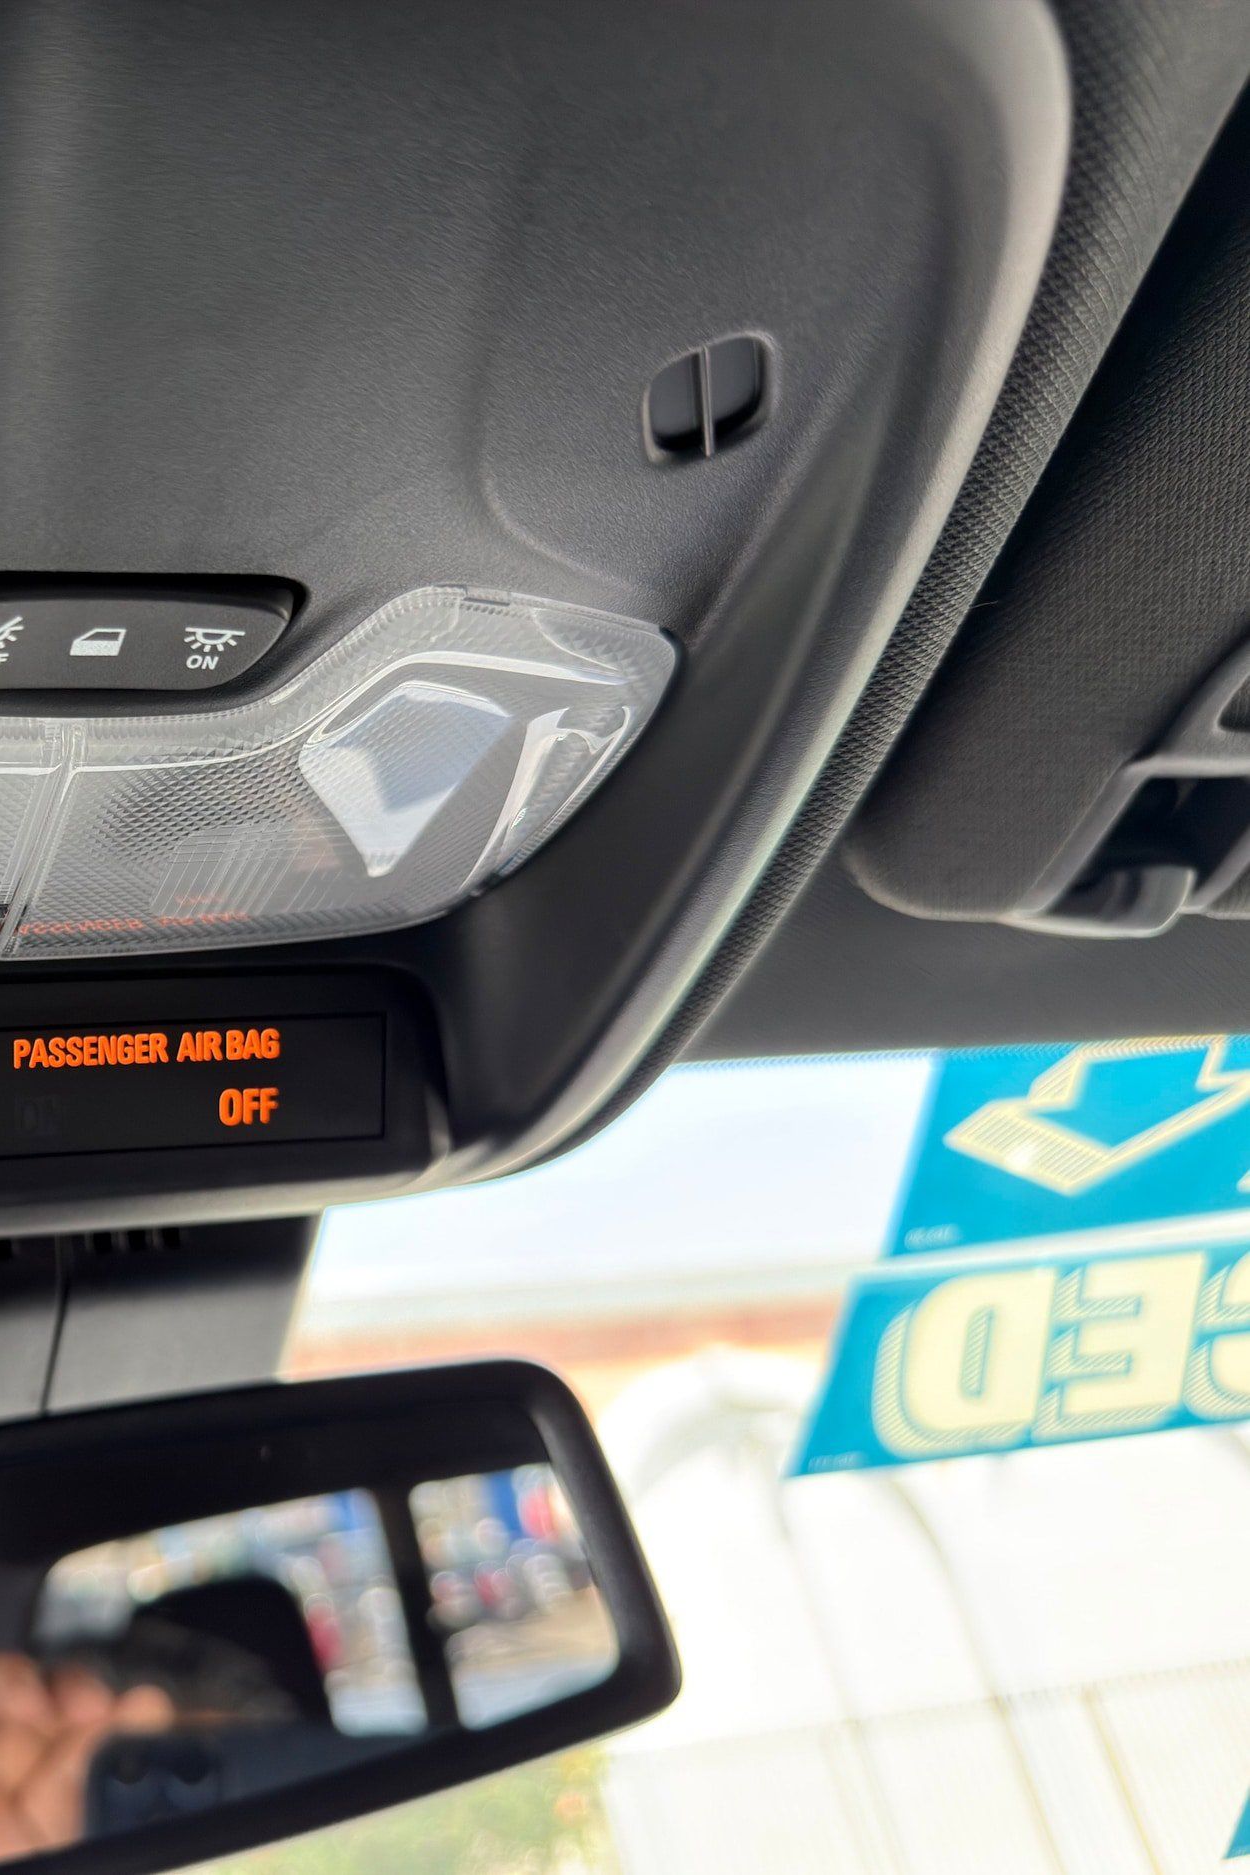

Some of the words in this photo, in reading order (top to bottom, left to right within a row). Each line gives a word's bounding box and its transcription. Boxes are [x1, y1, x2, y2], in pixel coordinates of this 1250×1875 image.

[186, 654, 218, 670] ON
[13, 1033, 168, 1069] PASSENGER
[177, 1031, 222, 1062] AIR
[226, 1028, 280, 1060] BAG
[219, 1087, 279, 1126] OFF
